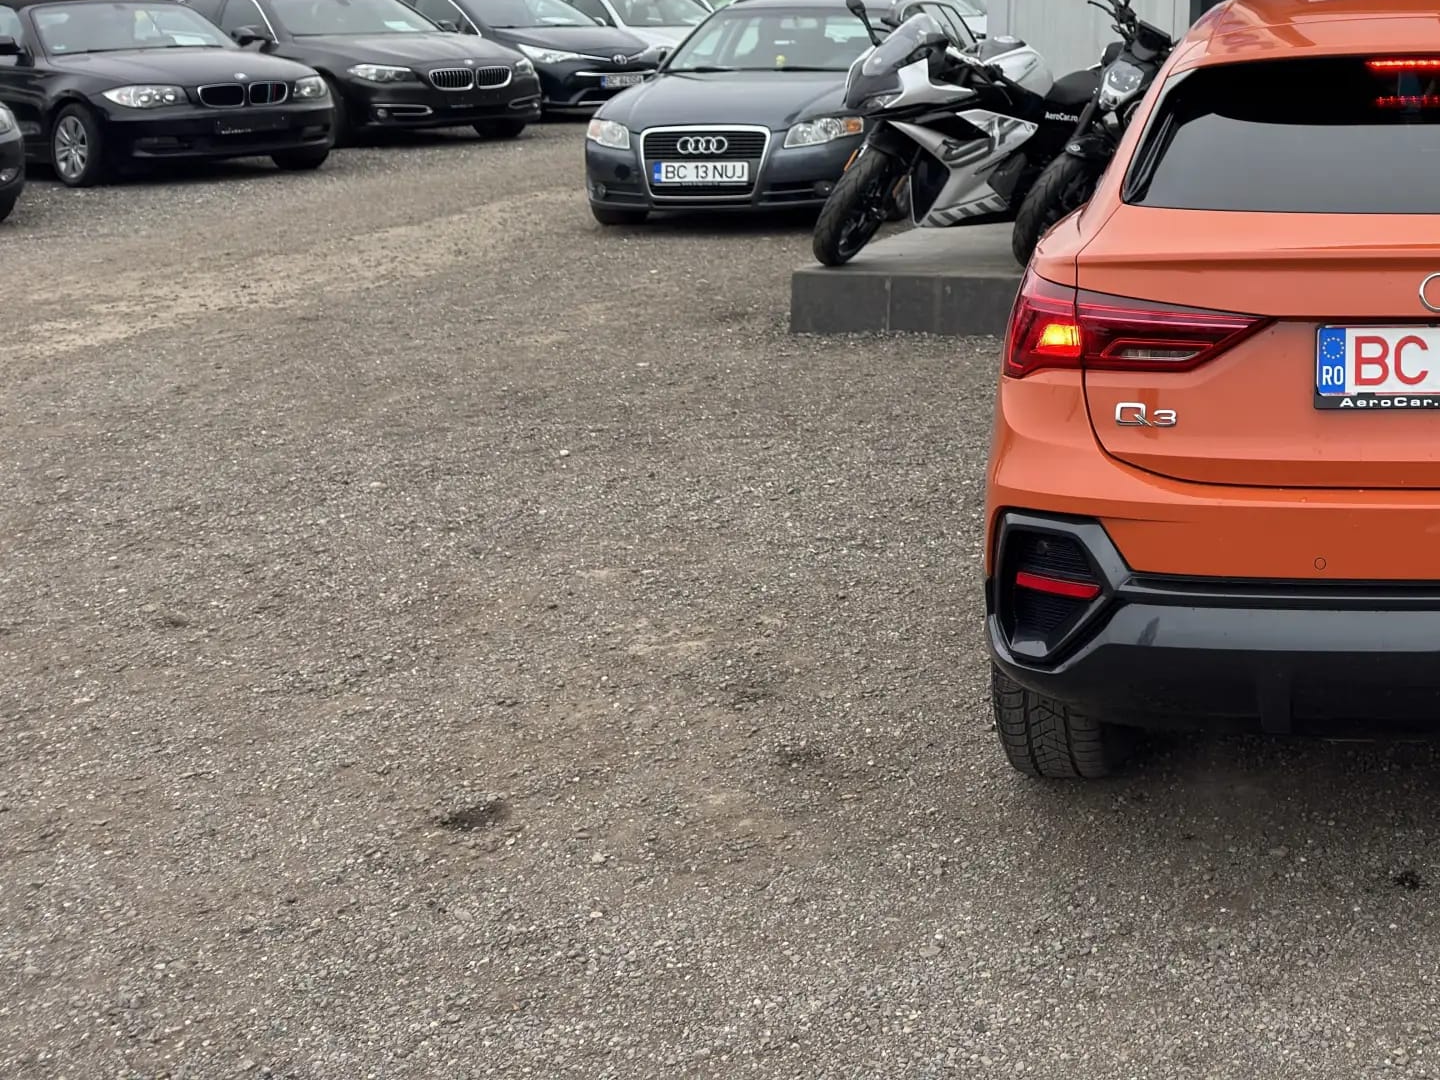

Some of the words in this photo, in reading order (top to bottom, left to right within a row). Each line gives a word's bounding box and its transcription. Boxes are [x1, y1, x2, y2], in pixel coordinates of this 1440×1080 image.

[664, 164, 688, 180] BC
[694, 164, 709, 180] 13
[712, 164, 745, 180] NUJ
[1353, 335, 1429, 387] BC
[1321, 365, 1344, 386] RO
[1115, 402, 1177, 427] Q3
